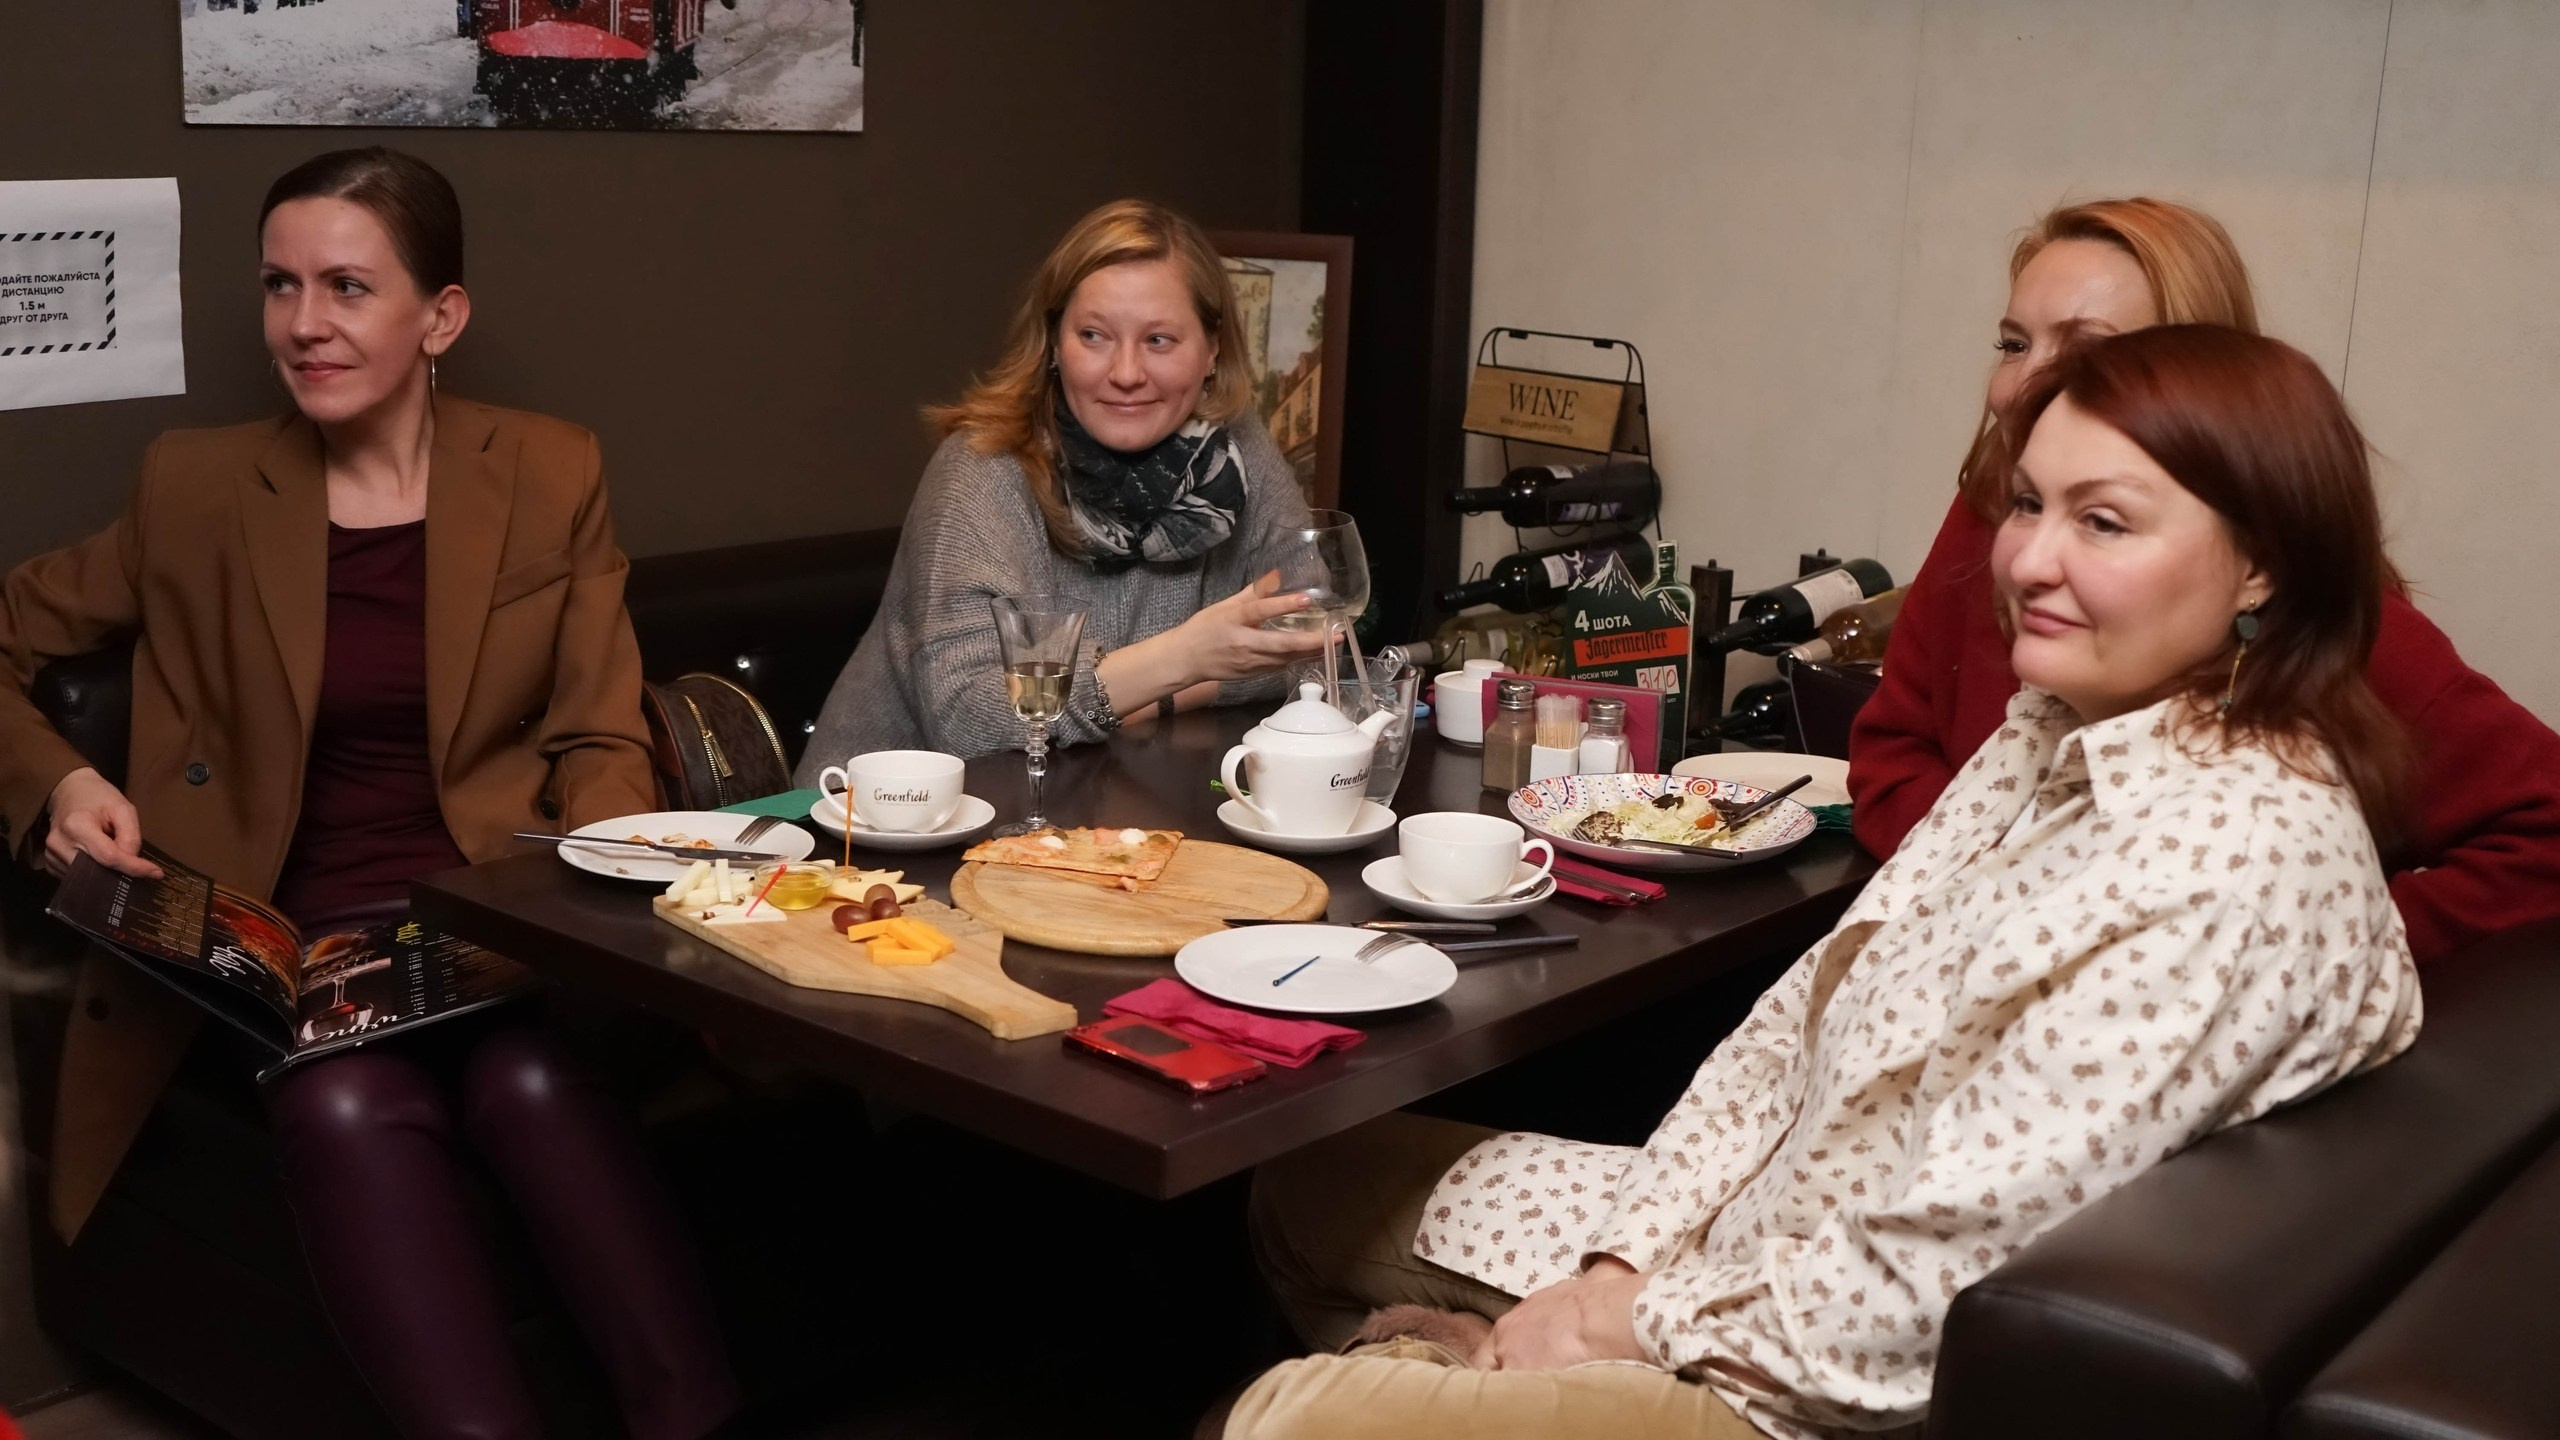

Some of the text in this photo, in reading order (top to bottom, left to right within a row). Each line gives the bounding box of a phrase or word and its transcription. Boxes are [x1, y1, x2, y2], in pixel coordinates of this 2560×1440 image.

[0, 272, 100, 285] ДАЙТЕ ПОЖАЛУЙСТА
[2, 286, 64, 298] ДИСТАНЦИЮ
[19, 301, 35, 310] 1.5
[0, 312, 69, 325] ДРУГ ОТ ДРУГА
[1509, 382, 1579, 421] WINE
[1574, 609, 1632, 632] 4 ШОТА
[1578, 671, 1600, 681] НОСКИ
[1601, 669, 1619, 678] ТВОИ
[874, 787, 930, 802] Greenfield
